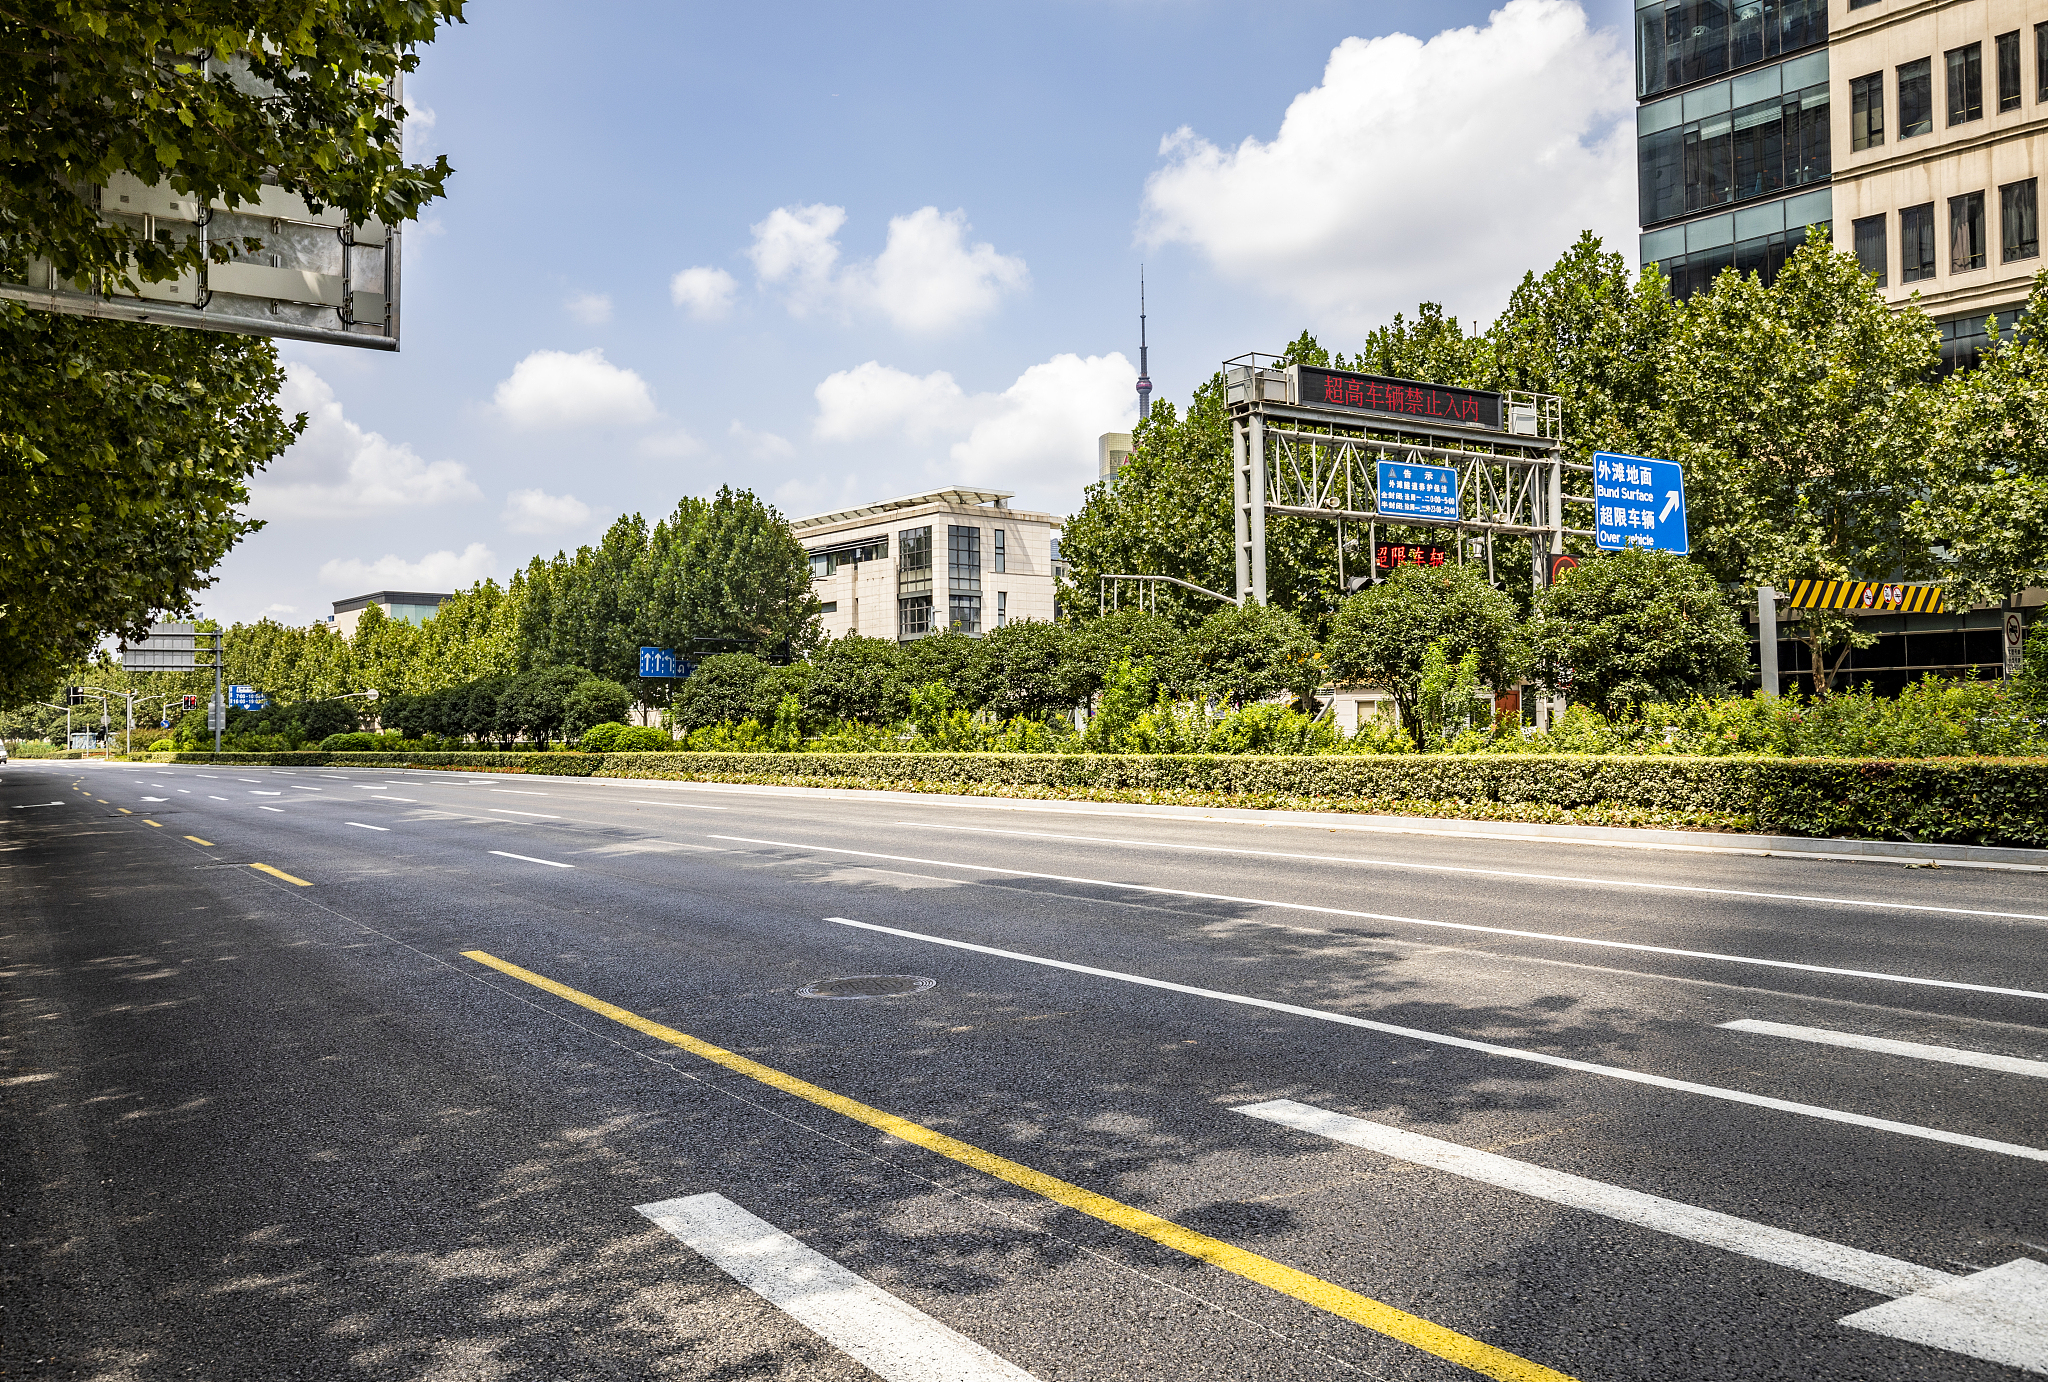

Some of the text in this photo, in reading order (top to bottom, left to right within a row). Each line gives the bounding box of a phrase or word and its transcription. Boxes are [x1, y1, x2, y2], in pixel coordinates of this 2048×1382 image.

[1324, 375, 1479, 422] 超高车辆禁止入内
[1598, 460, 1652, 487] 外滩地面
[1597, 485, 1654, 502] Bund Surface
[1600, 505, 1655, 530] 超限车辆
[1600, 530, 1621, 543] Over
